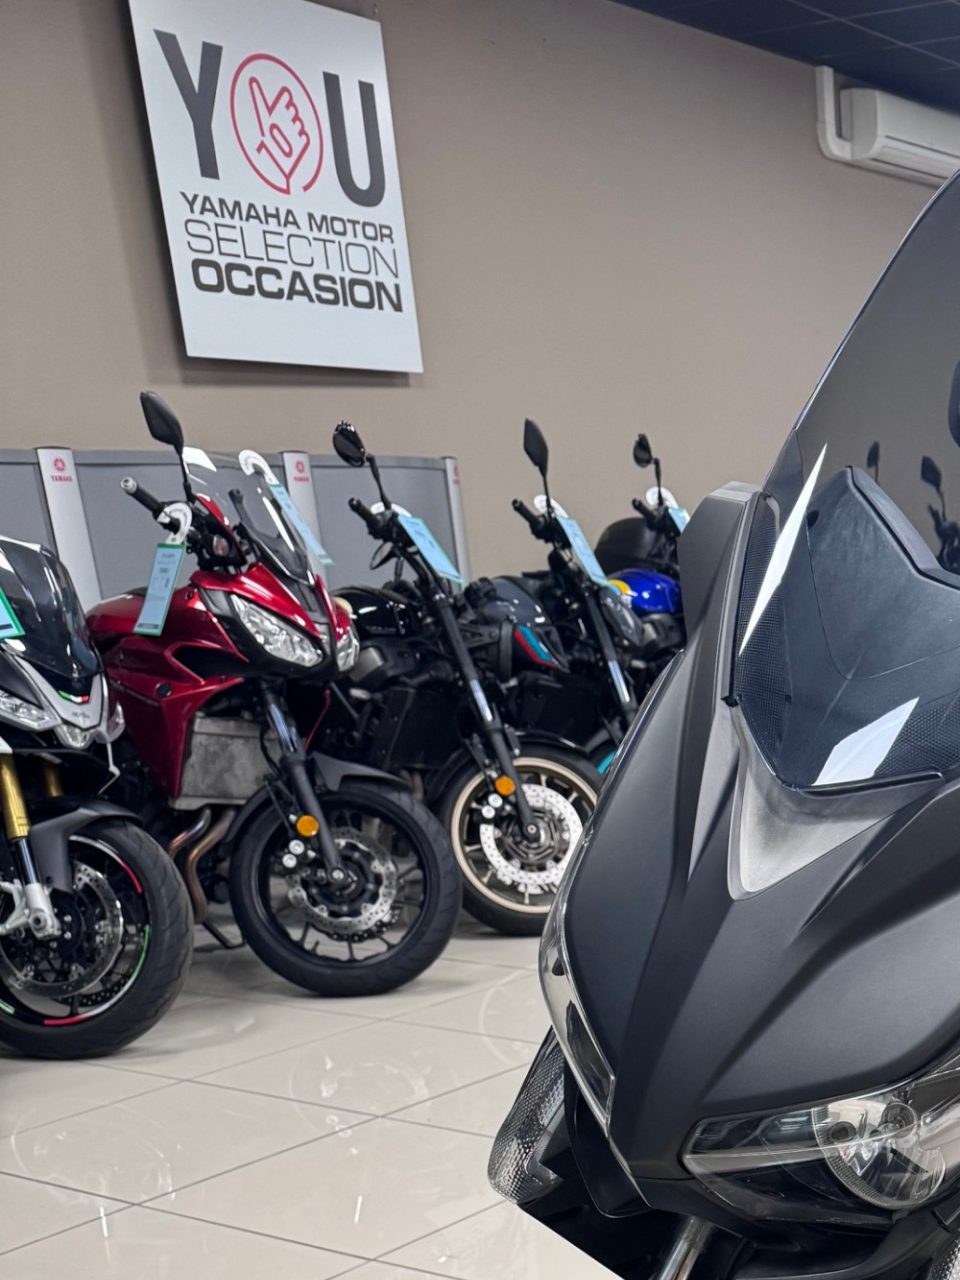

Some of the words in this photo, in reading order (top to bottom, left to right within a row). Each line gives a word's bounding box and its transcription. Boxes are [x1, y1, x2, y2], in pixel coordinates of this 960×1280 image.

[180, 191, 301, 229] YAMAHA
[307, 212, 395, 244] MOTOR
[184, 218, 399, 279] SELECTION
[191, 258, 404, 313] OCCASION
